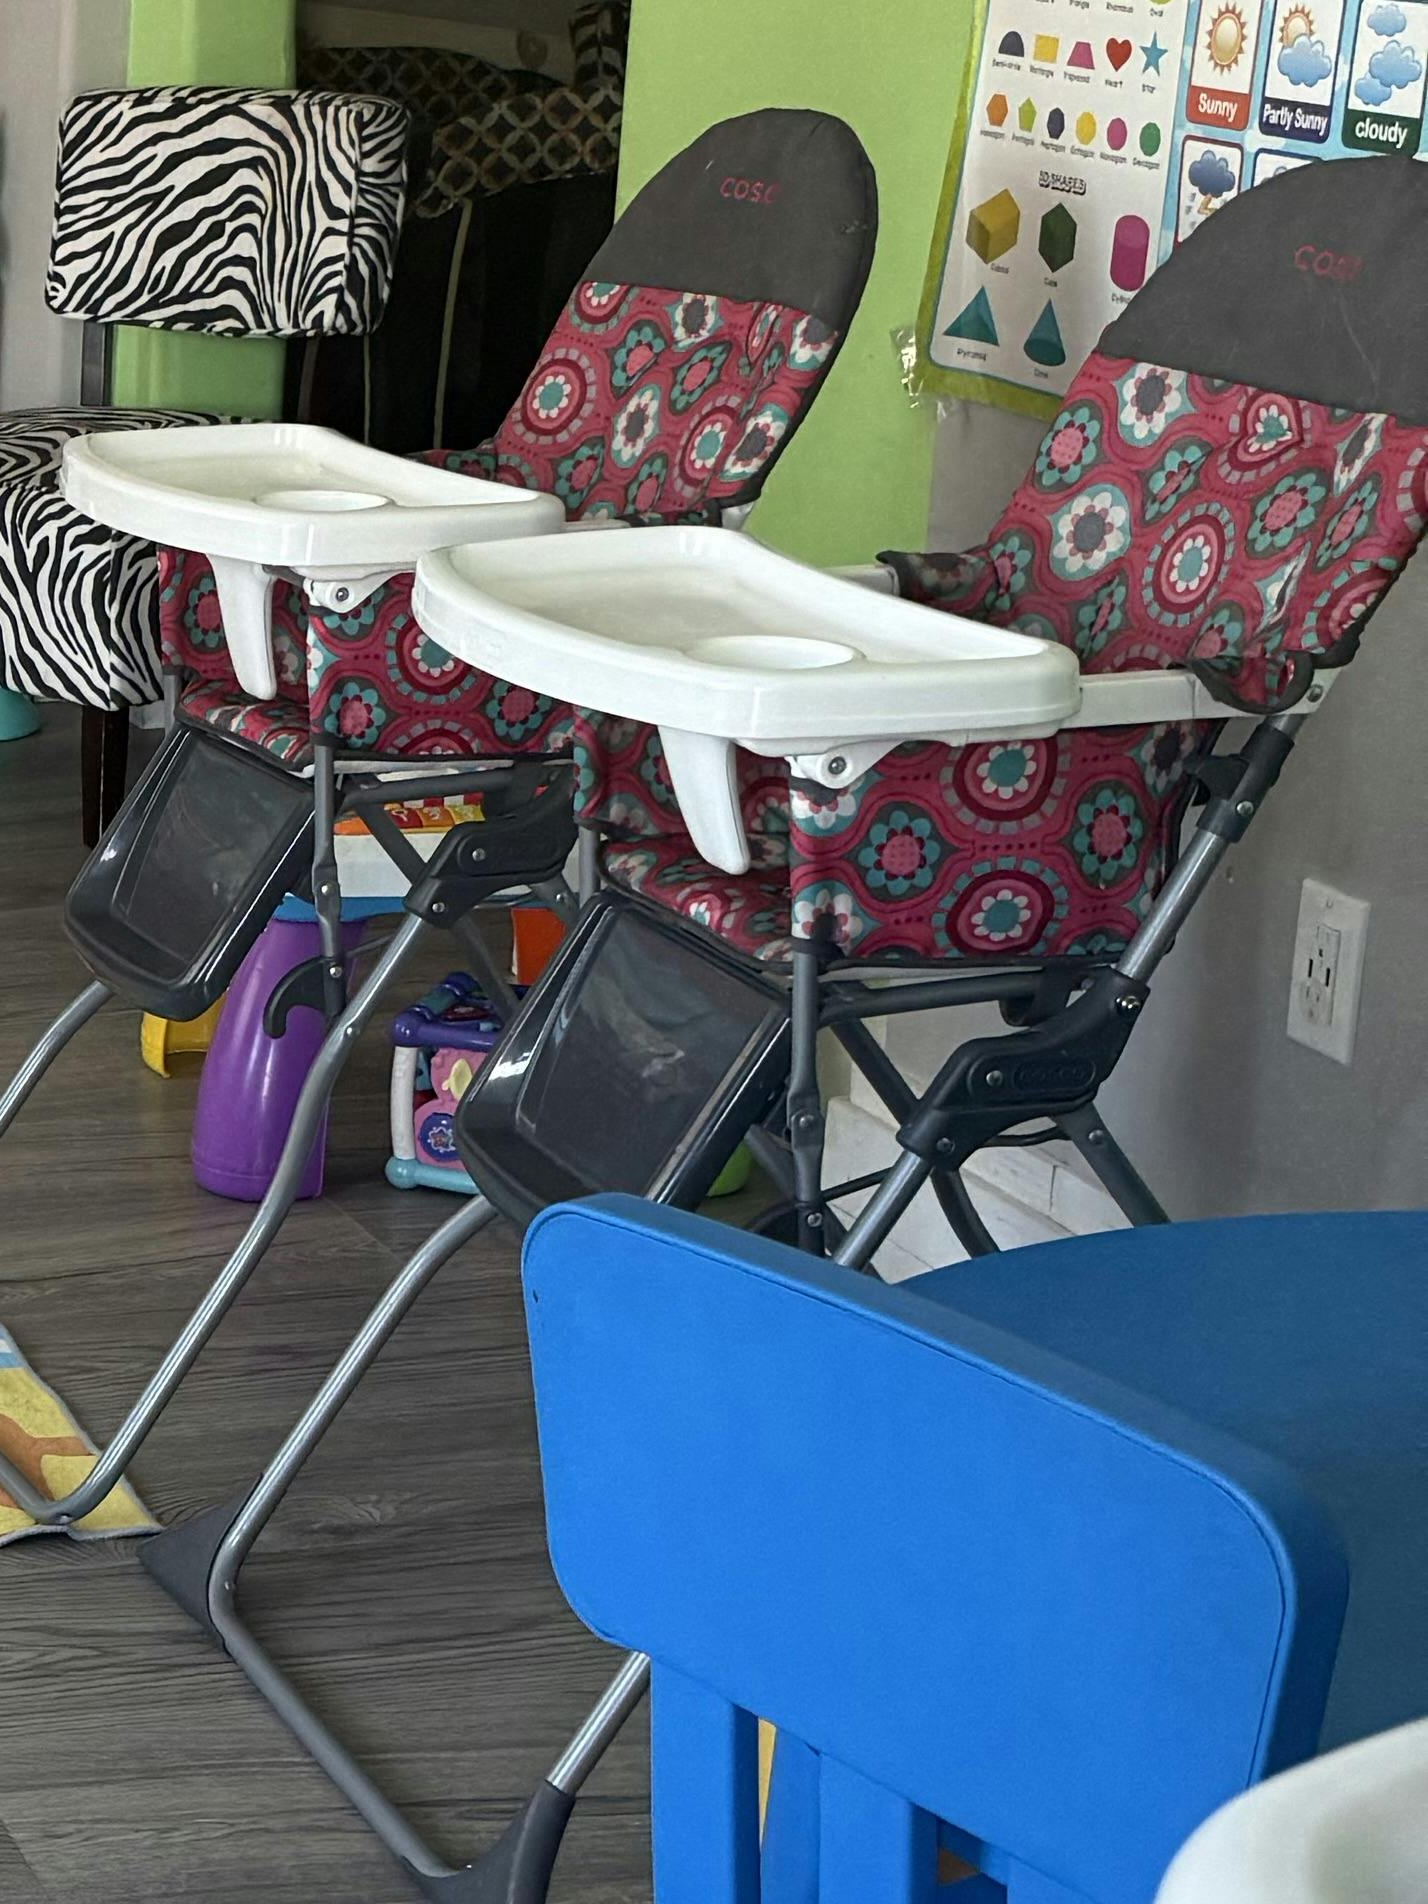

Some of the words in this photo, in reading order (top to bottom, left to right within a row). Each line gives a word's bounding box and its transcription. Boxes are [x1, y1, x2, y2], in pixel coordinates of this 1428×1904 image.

[1198, 93, 1238, 123] Sunny
[1262, 105, 1293, 127] Partly
[1294, 110, 1328, 137] Sunny
[1354, 117, 1408, 149] cloudy
